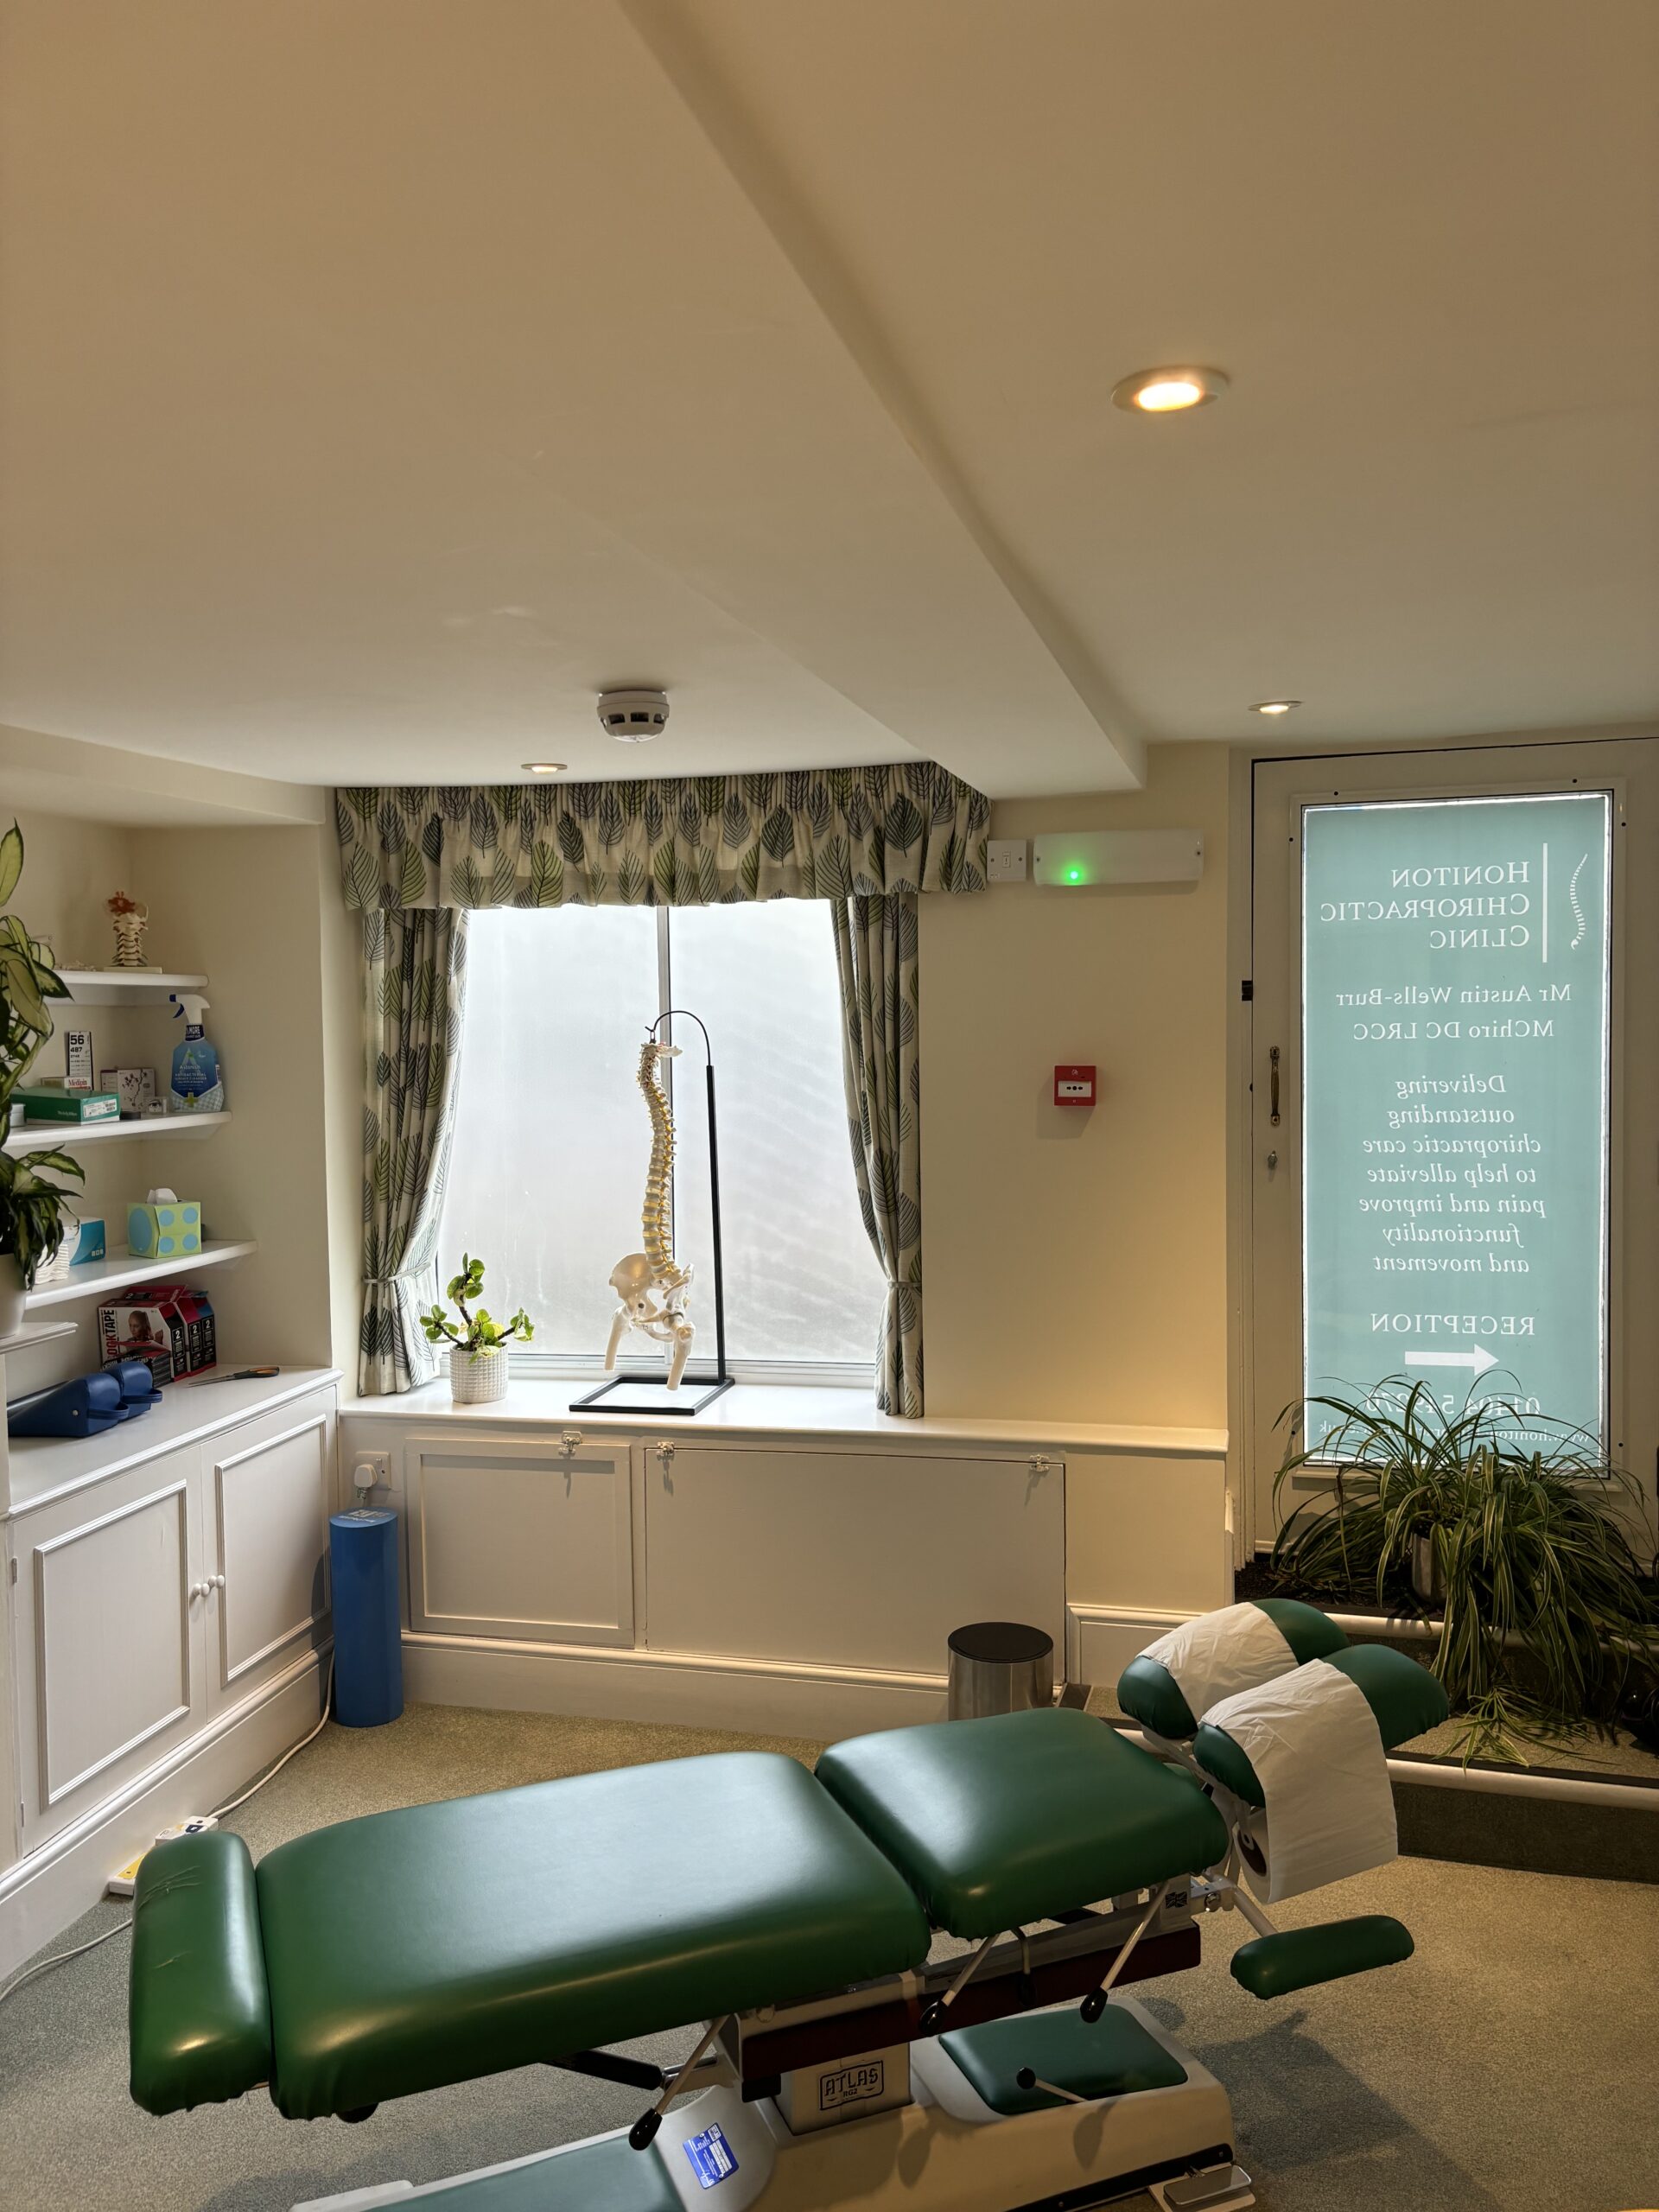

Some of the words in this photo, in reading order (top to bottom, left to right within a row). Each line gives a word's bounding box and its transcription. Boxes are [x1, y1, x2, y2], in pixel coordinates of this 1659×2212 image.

[70, 1034, 85, 1046] 56
[175, 1330, 181, 1339] 2
[824, 2068, 878, 2097] ATLAS
